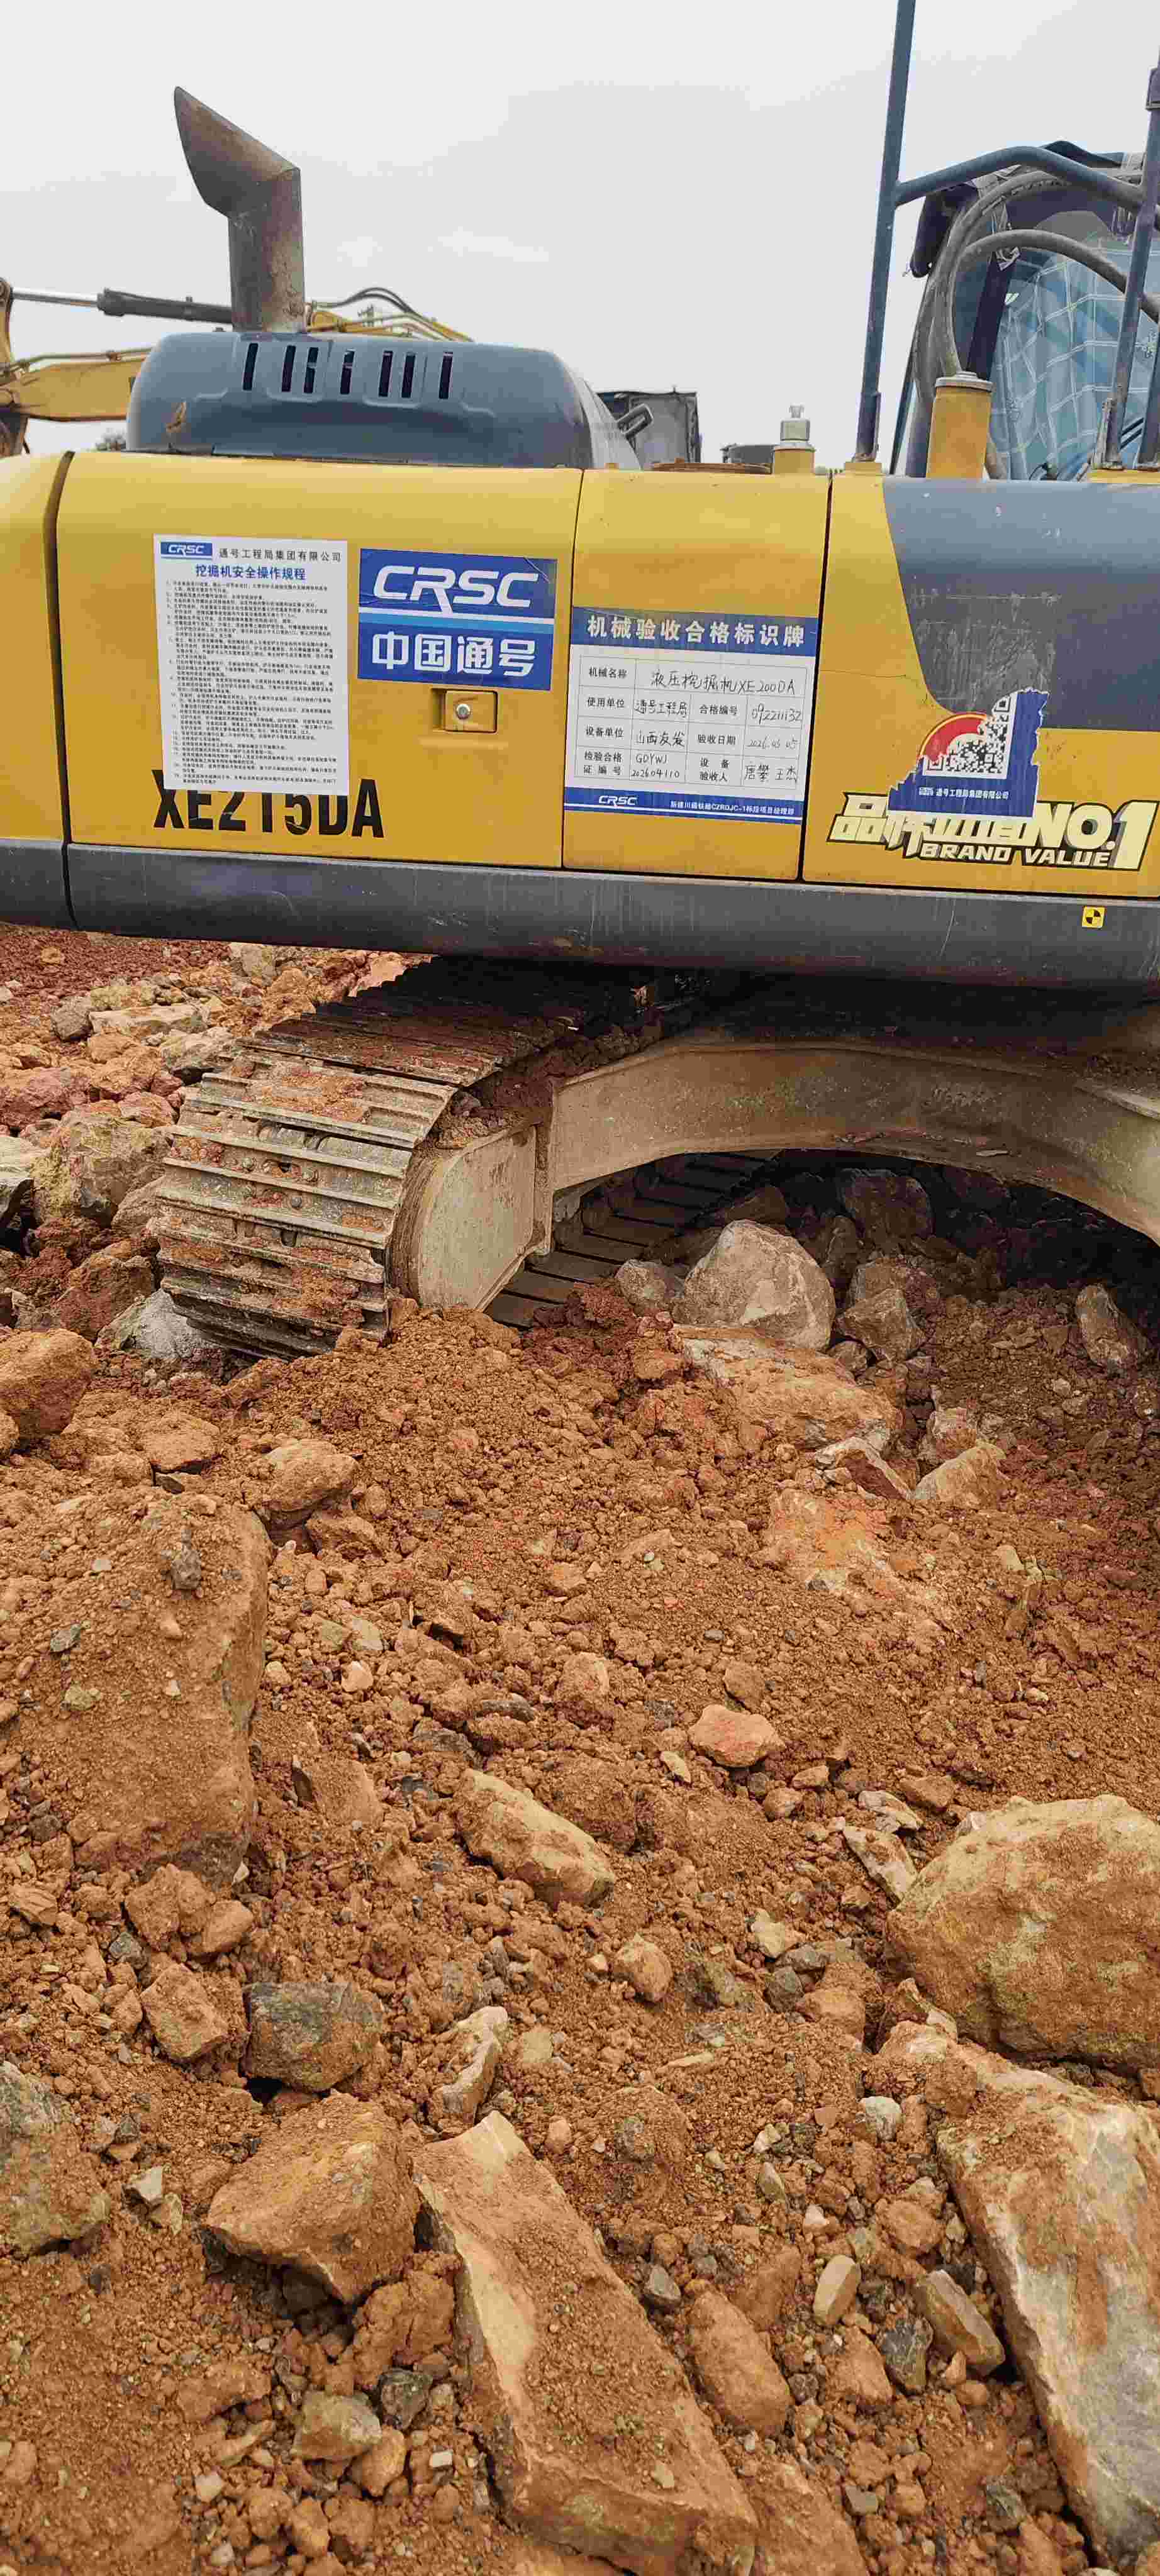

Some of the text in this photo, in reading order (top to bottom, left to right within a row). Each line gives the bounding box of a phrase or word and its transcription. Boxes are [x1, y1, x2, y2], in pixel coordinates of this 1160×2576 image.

[168, 543, 204, 556] CRSC
[219, 548, 341, 562] 通号工程局集团有限公司
[195, 564, 306, 580] 挖掘机安全操作规程
[373, 565, 539, 614] CRSC
[587, 615, 805, 647] 机械验收合格标识牌
[372, 631, 537, 676] 中国通号
[588, 667, 627, 680] 机械名称
[587, 697, 625, 708] 使用单位
[699, 704, 739, 716] 合格编号
[585, 726, 624, 738] 设备单位
[697, 734, 736, 746] 验收日期
[584, 752, 622, 763] 检验合格
[700, 770, 728, 782] 验收人
[598, 795, 639, 807] CRSC
[919, 841, 1112, 868] BRAND VALUE
